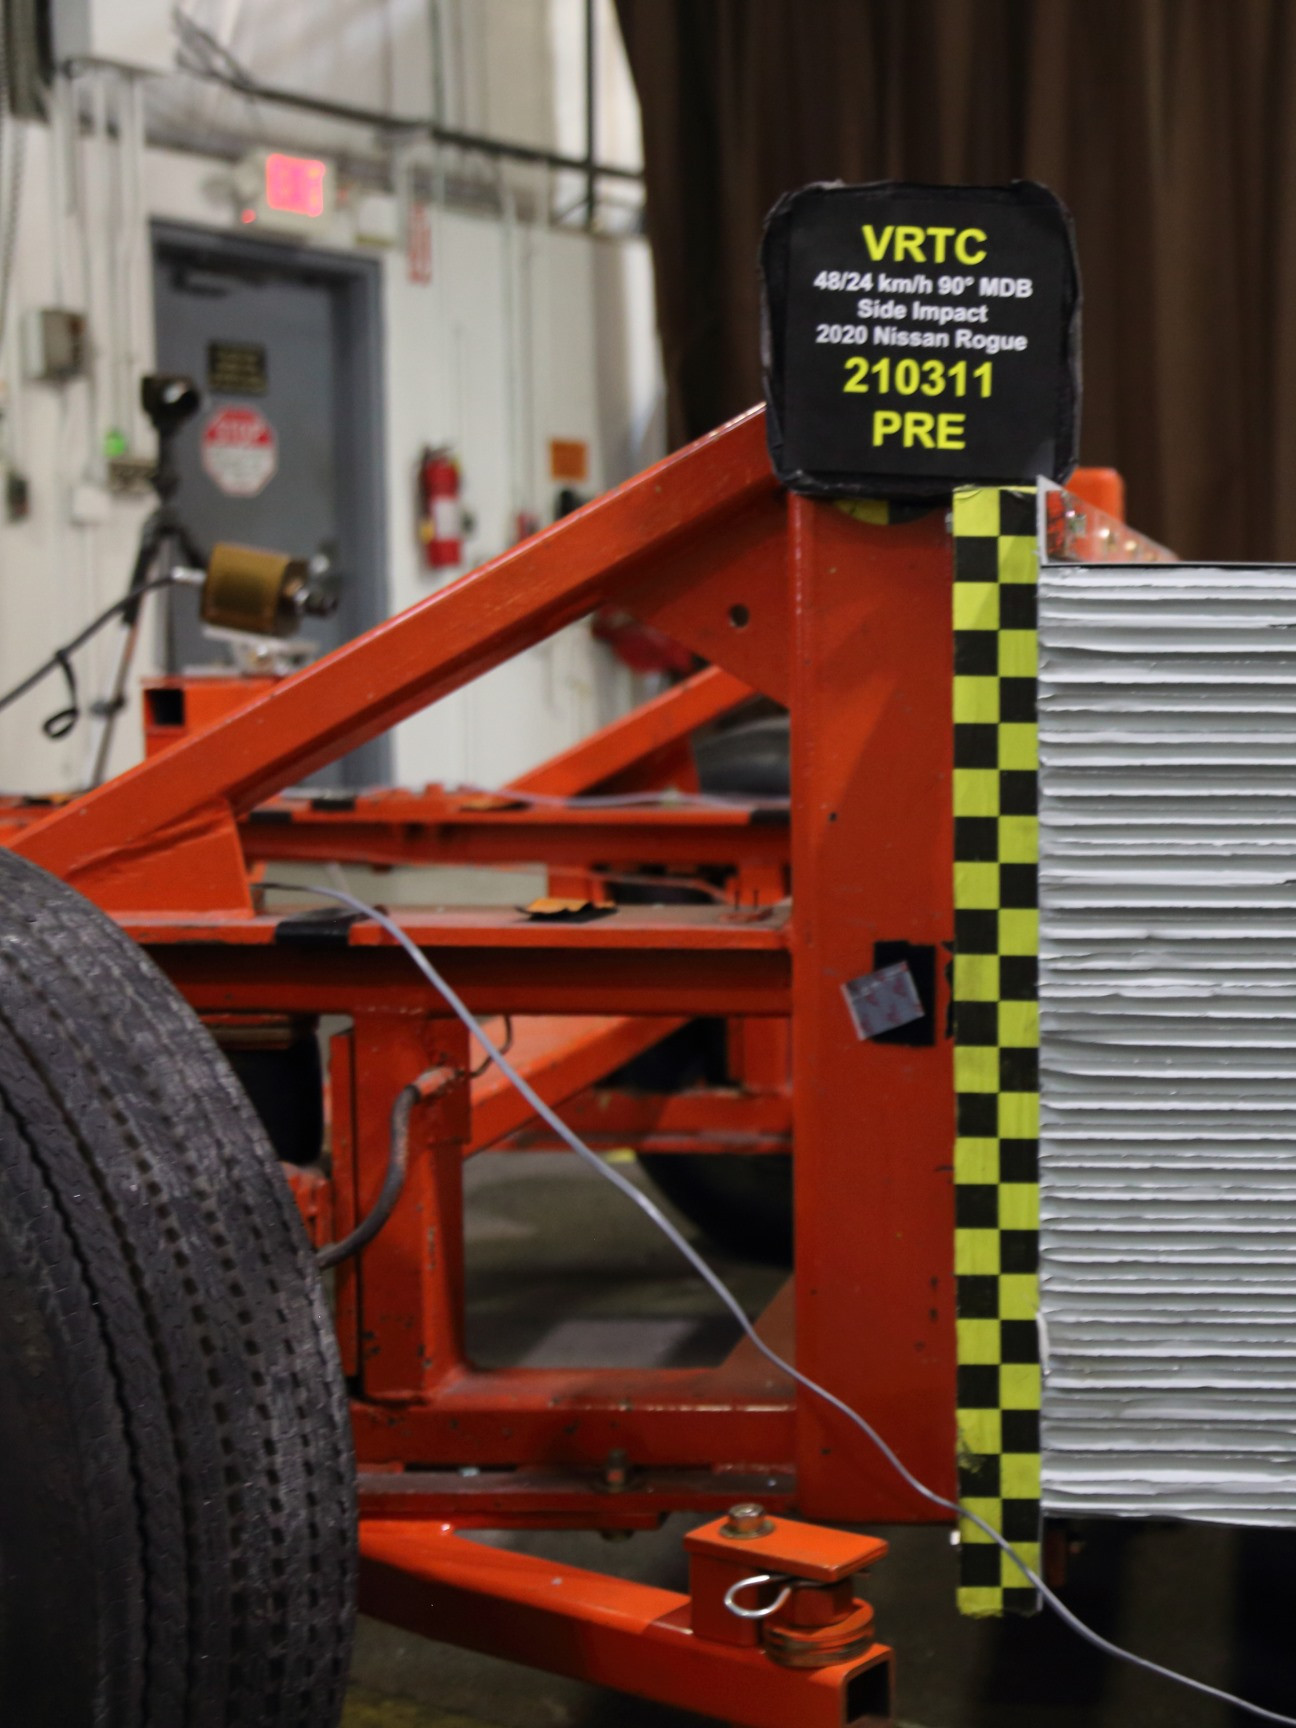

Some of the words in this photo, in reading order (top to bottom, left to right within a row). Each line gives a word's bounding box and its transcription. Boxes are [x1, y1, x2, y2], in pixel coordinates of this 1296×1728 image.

[862, 225, 986, 265] VRTC
[814, 271, 873, 291] 48/24
[878, 273, 933, 294] km/h
[979, 277, 1032, 297] MDB
[858, 299, 907, 319] Side
[912, 301, 988, 325] Impact
[817, 324, 868, 344] 2020
[873, 326, 949, 347] Nissan
[955, 329, 1027, 354] Rogue
[844, 357, 992, 397] 210311
[873, 411, 965, 449] PRE
